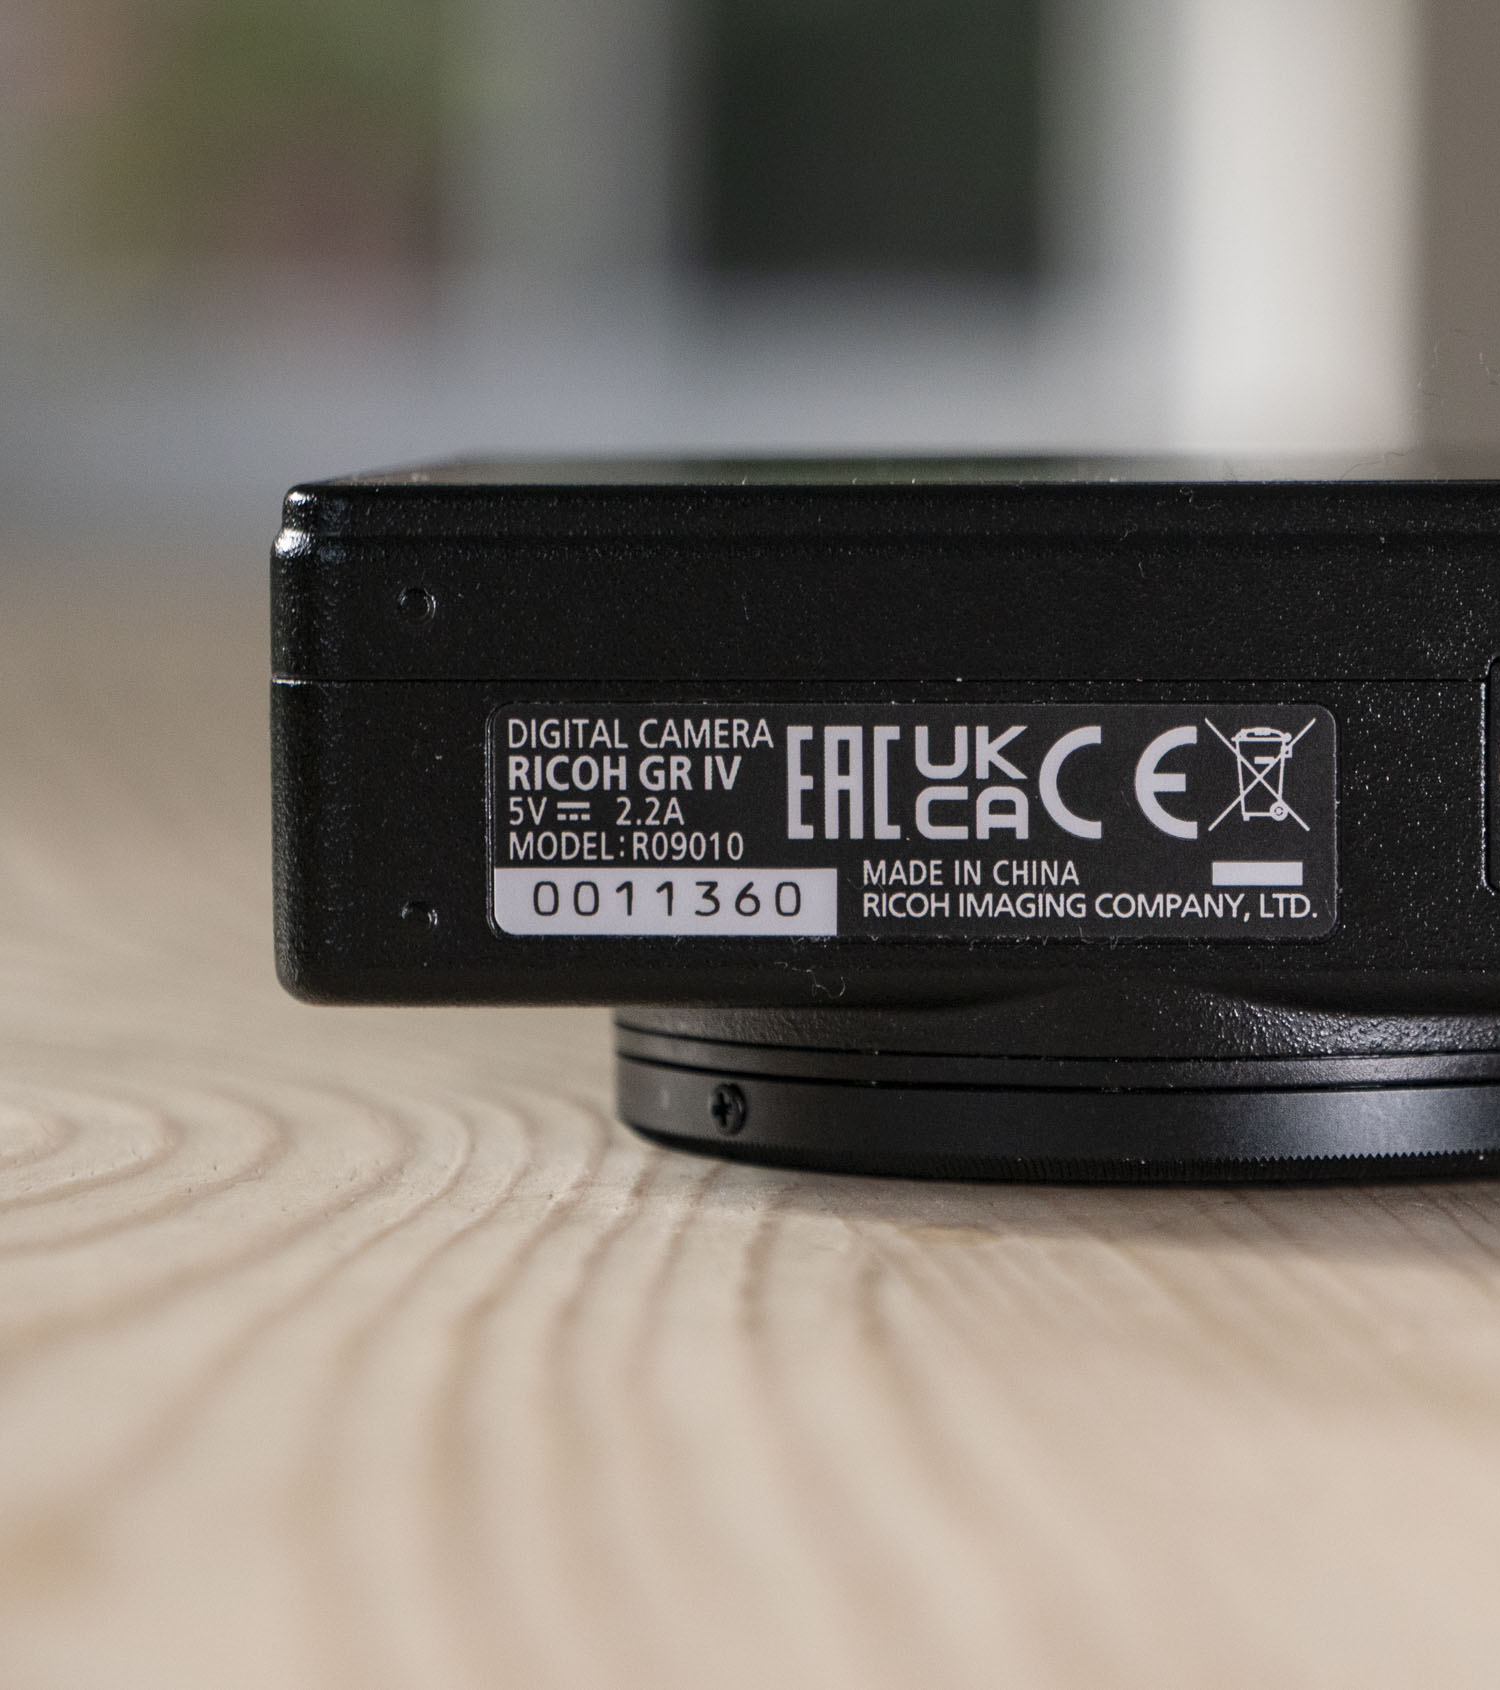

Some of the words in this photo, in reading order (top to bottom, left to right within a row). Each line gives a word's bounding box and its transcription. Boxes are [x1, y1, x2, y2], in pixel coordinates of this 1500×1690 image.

[509, 719, 628, 748] DIGITAL
[640, 719, 773, 748] CAMERA
[915, 726, 1027, 779] UK
[509, 755, 626, 790] RICOH
[639, 756, 692, 791] GR
[705, 756, 741, 790] IV
[1039, 726, 1197, 839] CE
[510, 797, 547, 825] 5V
[617, 797, 684, 825] 2.2A
[916, 786, 1028, 839] CA
[864, 860, 943, 885] MADE
[955, 860, 981, 885] IN
[993, 860, 1079, 885] CHINA
[533, 881, 800, 916] 0011360
[864, 893, 949, 917] RICOH
[959, 893, 1086, 918] IMAGING
[1095, 893, 1250, 922] COMPANY,
[1260, 893, 1317, 918] LTD.
